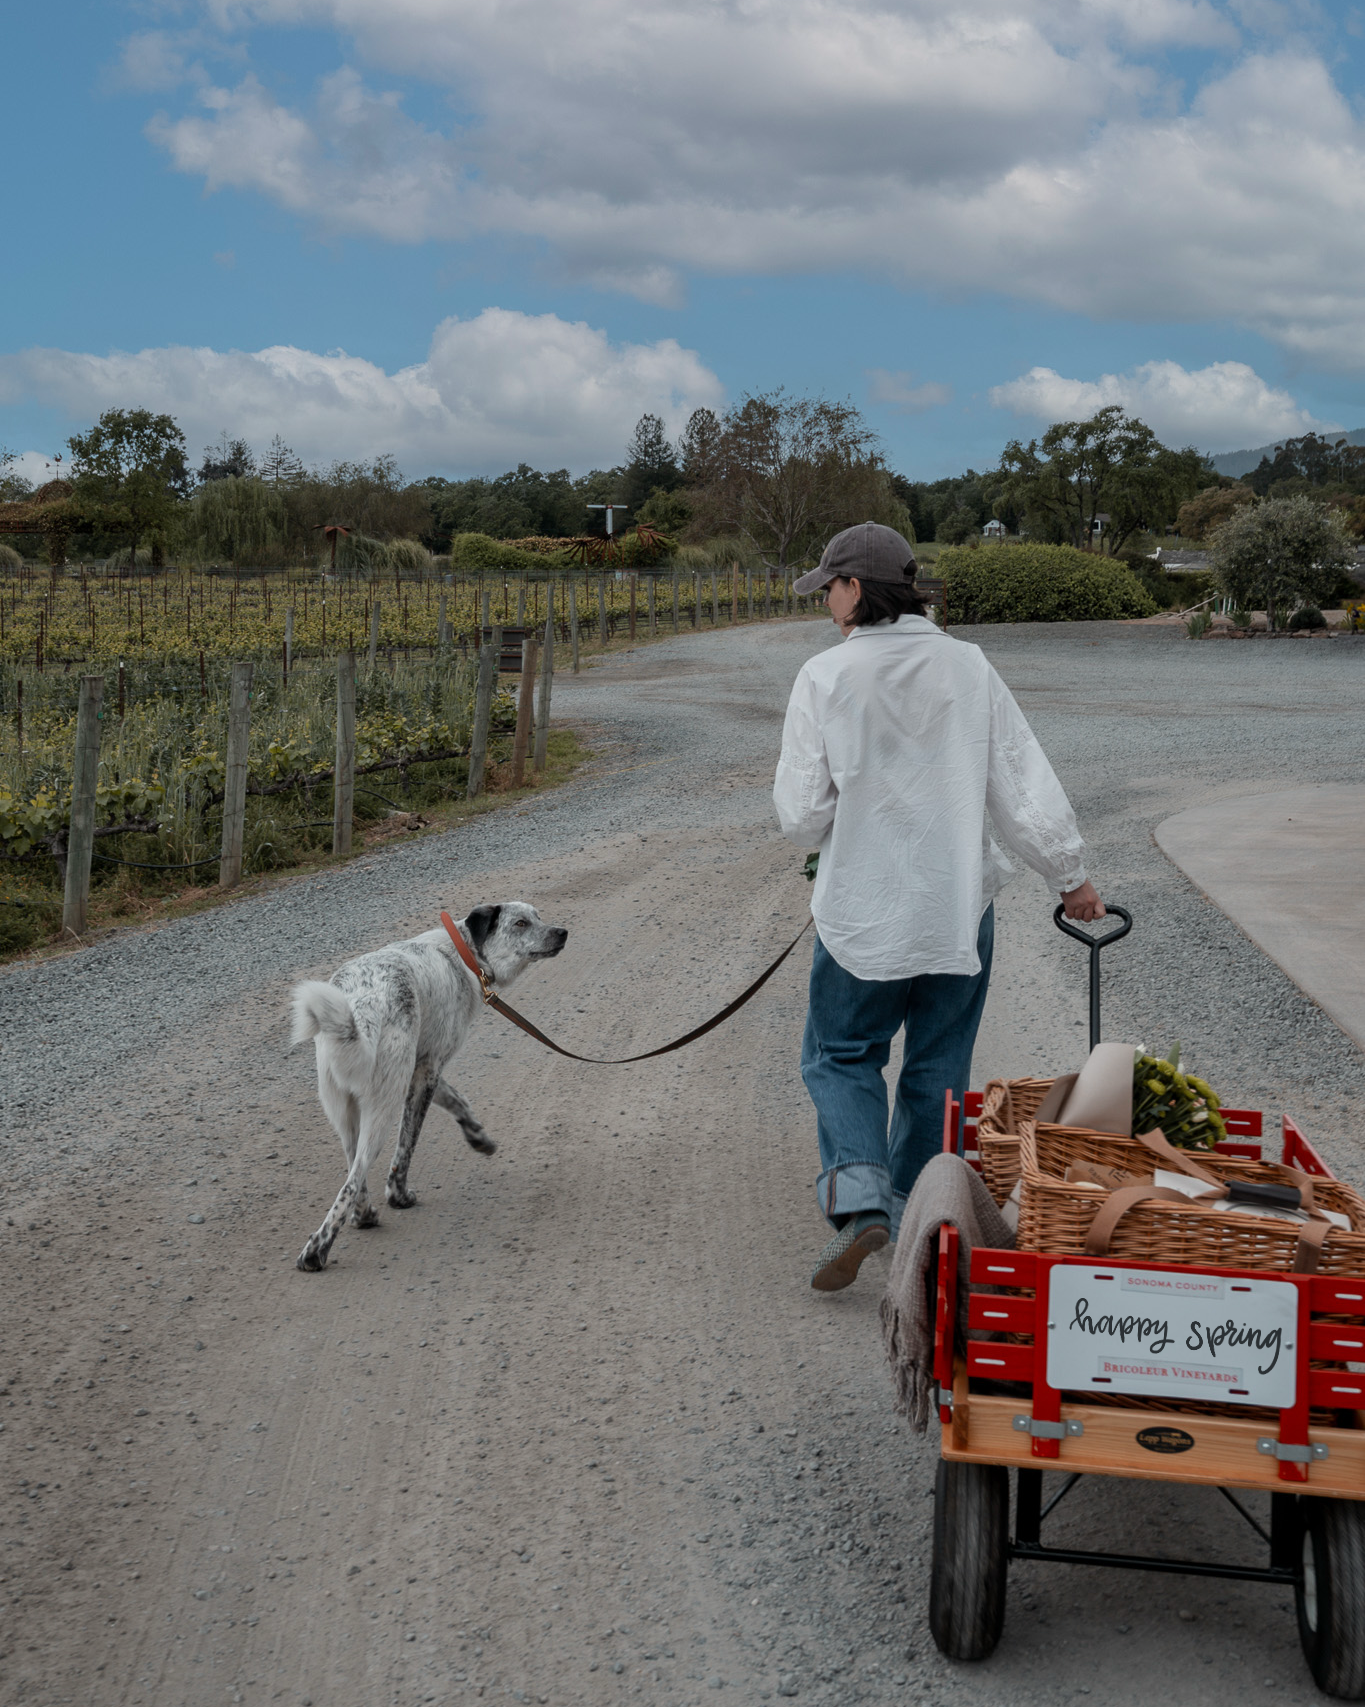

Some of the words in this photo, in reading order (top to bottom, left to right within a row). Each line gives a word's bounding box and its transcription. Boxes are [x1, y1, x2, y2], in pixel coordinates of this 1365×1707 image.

[1128, 1278, 1172, 1288] SONOMA
[1175, 1282, 1218, 1292] COUNTY
[1069, 1298, 1175, 1354] happy
[1186, 1320, 1283, 1375] spring
[1104, 1362, 1168, 1377] BRICOLEUR
[1171, 1367, 1239, 1383] VINEYARDS
